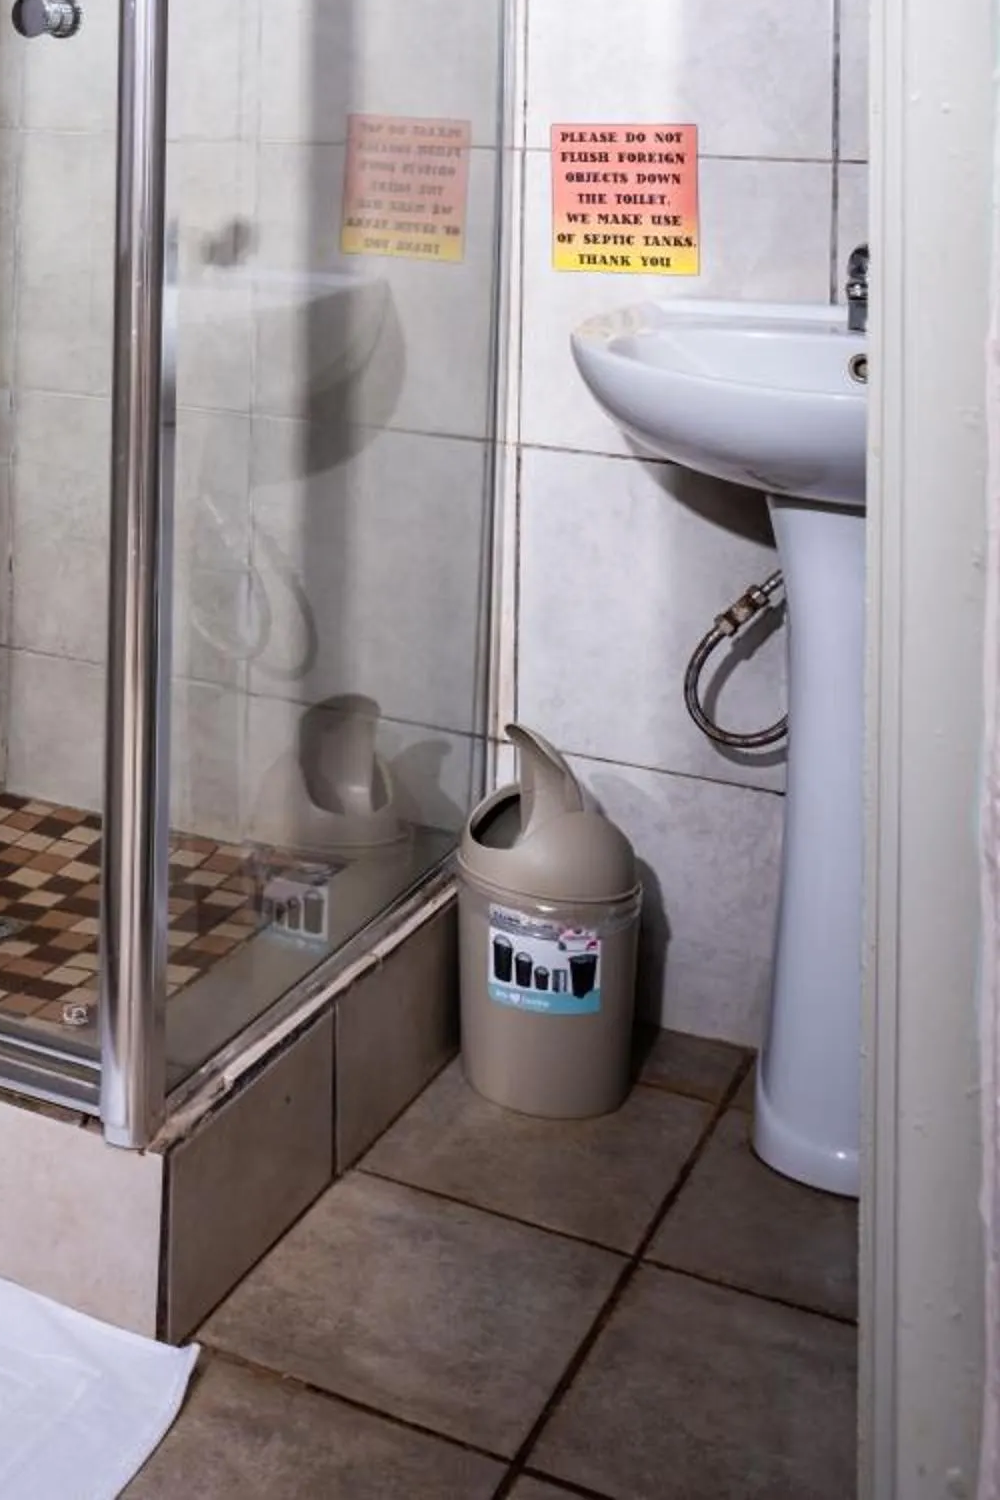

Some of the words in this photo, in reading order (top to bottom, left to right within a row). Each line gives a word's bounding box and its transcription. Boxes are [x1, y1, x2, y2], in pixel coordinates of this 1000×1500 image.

[560, 131, 617, 143] PLEASE
[625, 132, 646, 143] DO
[654, 132, 683, 144] NOT
[560, 151, 609, 163] FLUSH
[617, 152, 686, 164] FOREIGN
[565, 172, 629, 184] OBJECTS
[636, 173, 681, 185] DOWN
[577, 193, 607, 205] THE
[566, 212, 590, 224] WE
[597, 213, 643, 225] MAKE
[651, 215, 682, 226] USE
[557, 233, 576, 244] OF
[583, 234, 635, 246] SEPTIC
[578, 253, 631, 267] THANK
[640, 256, 671, 268] YOU
